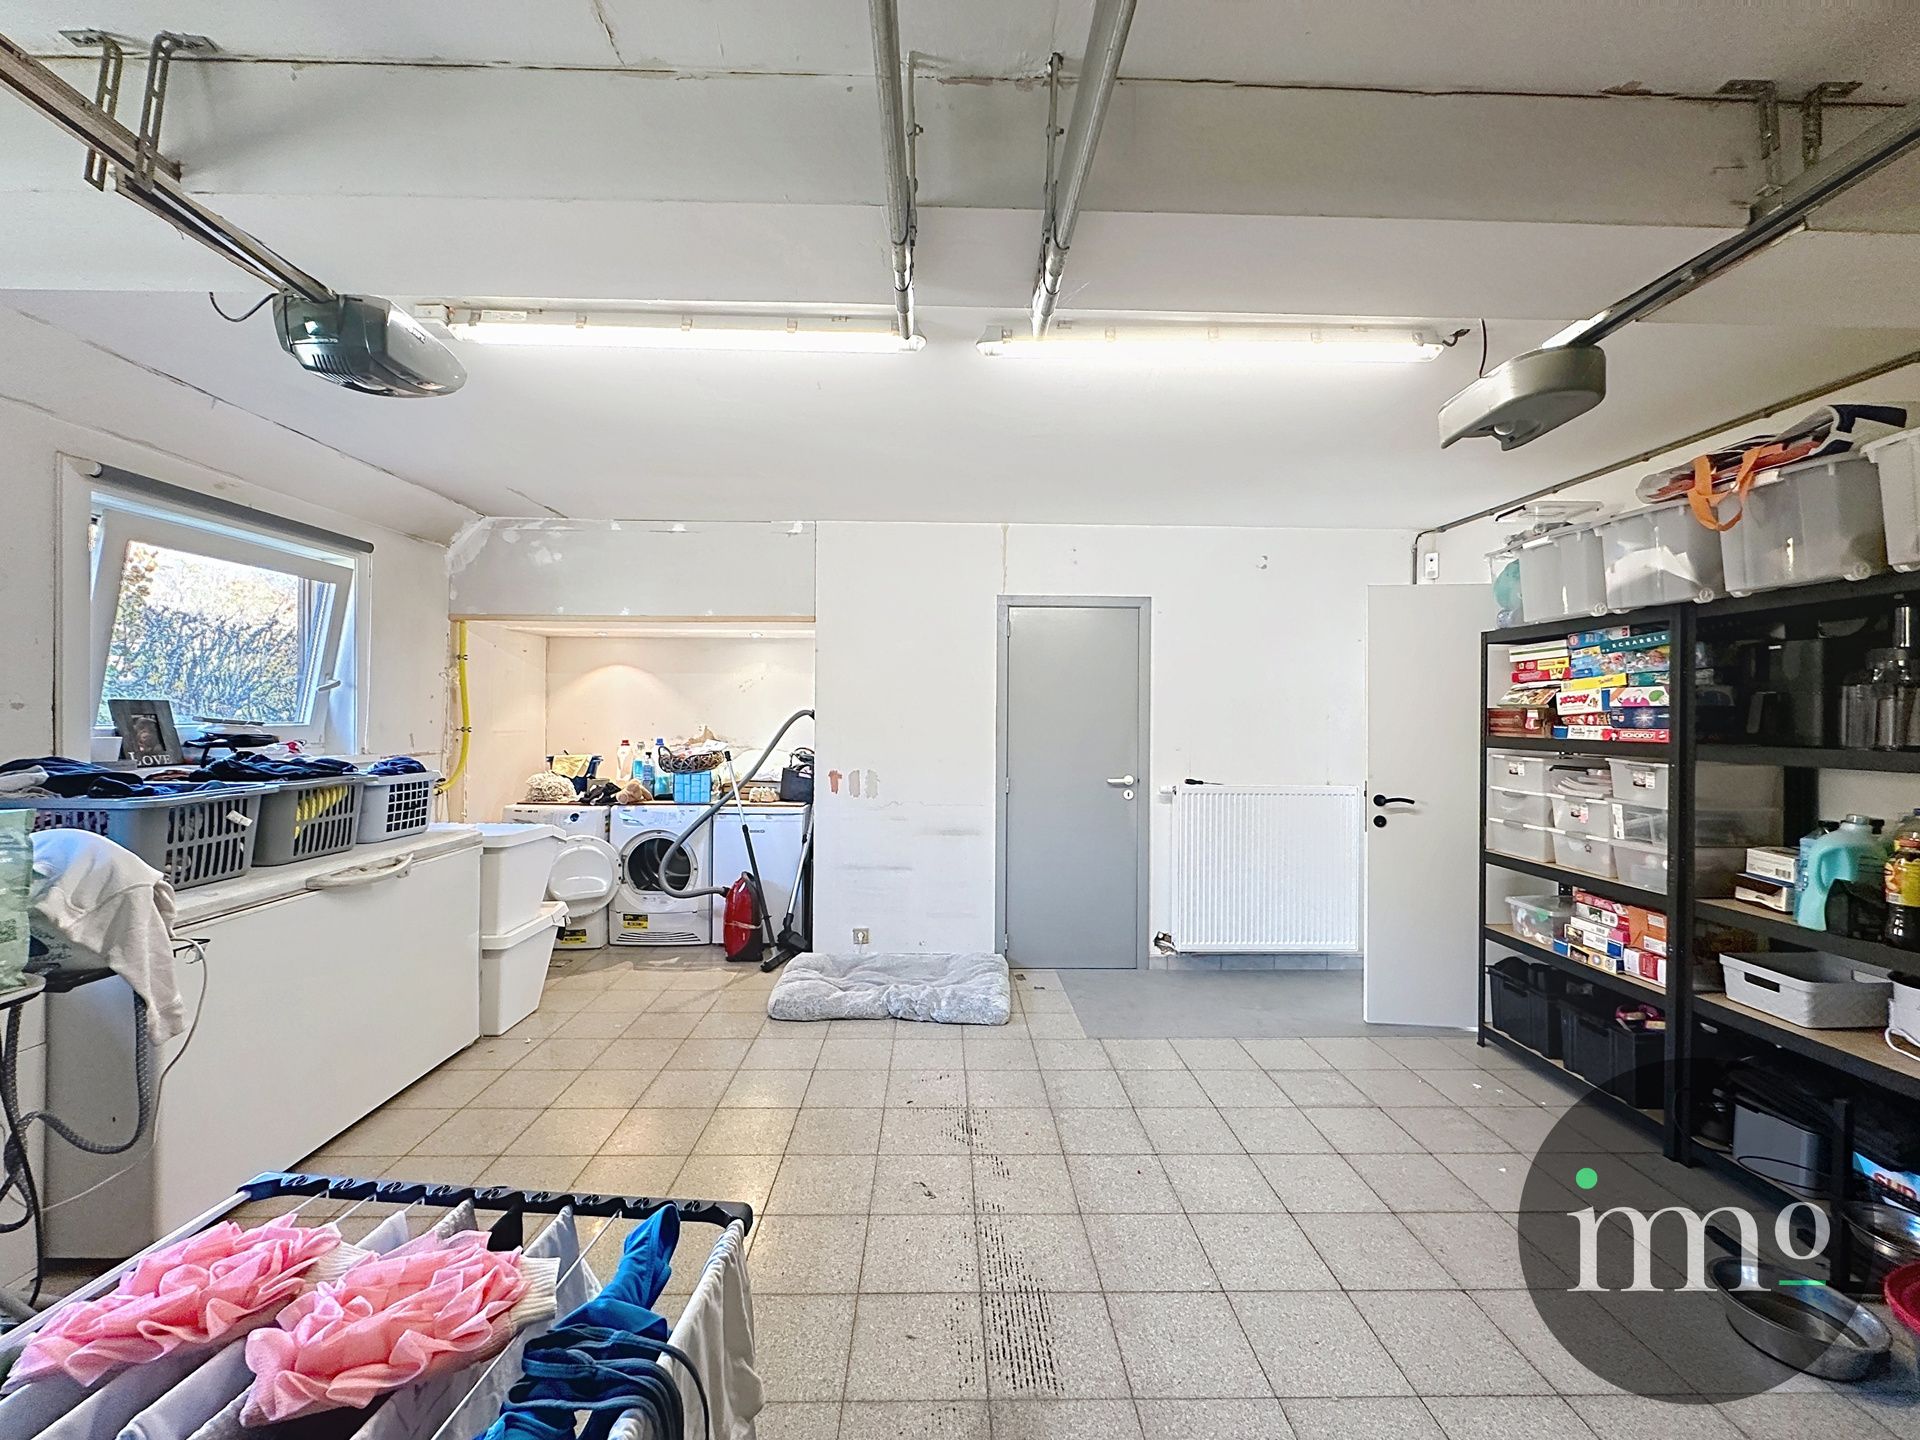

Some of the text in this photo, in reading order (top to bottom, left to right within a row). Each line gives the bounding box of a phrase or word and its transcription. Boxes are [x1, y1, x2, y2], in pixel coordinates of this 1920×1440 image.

[1611, 634, 1667, 650] SCRABBLE
[1620, 731, 1656, 740] MONOPOLY
[127, 752, 172, 766] LOVE
